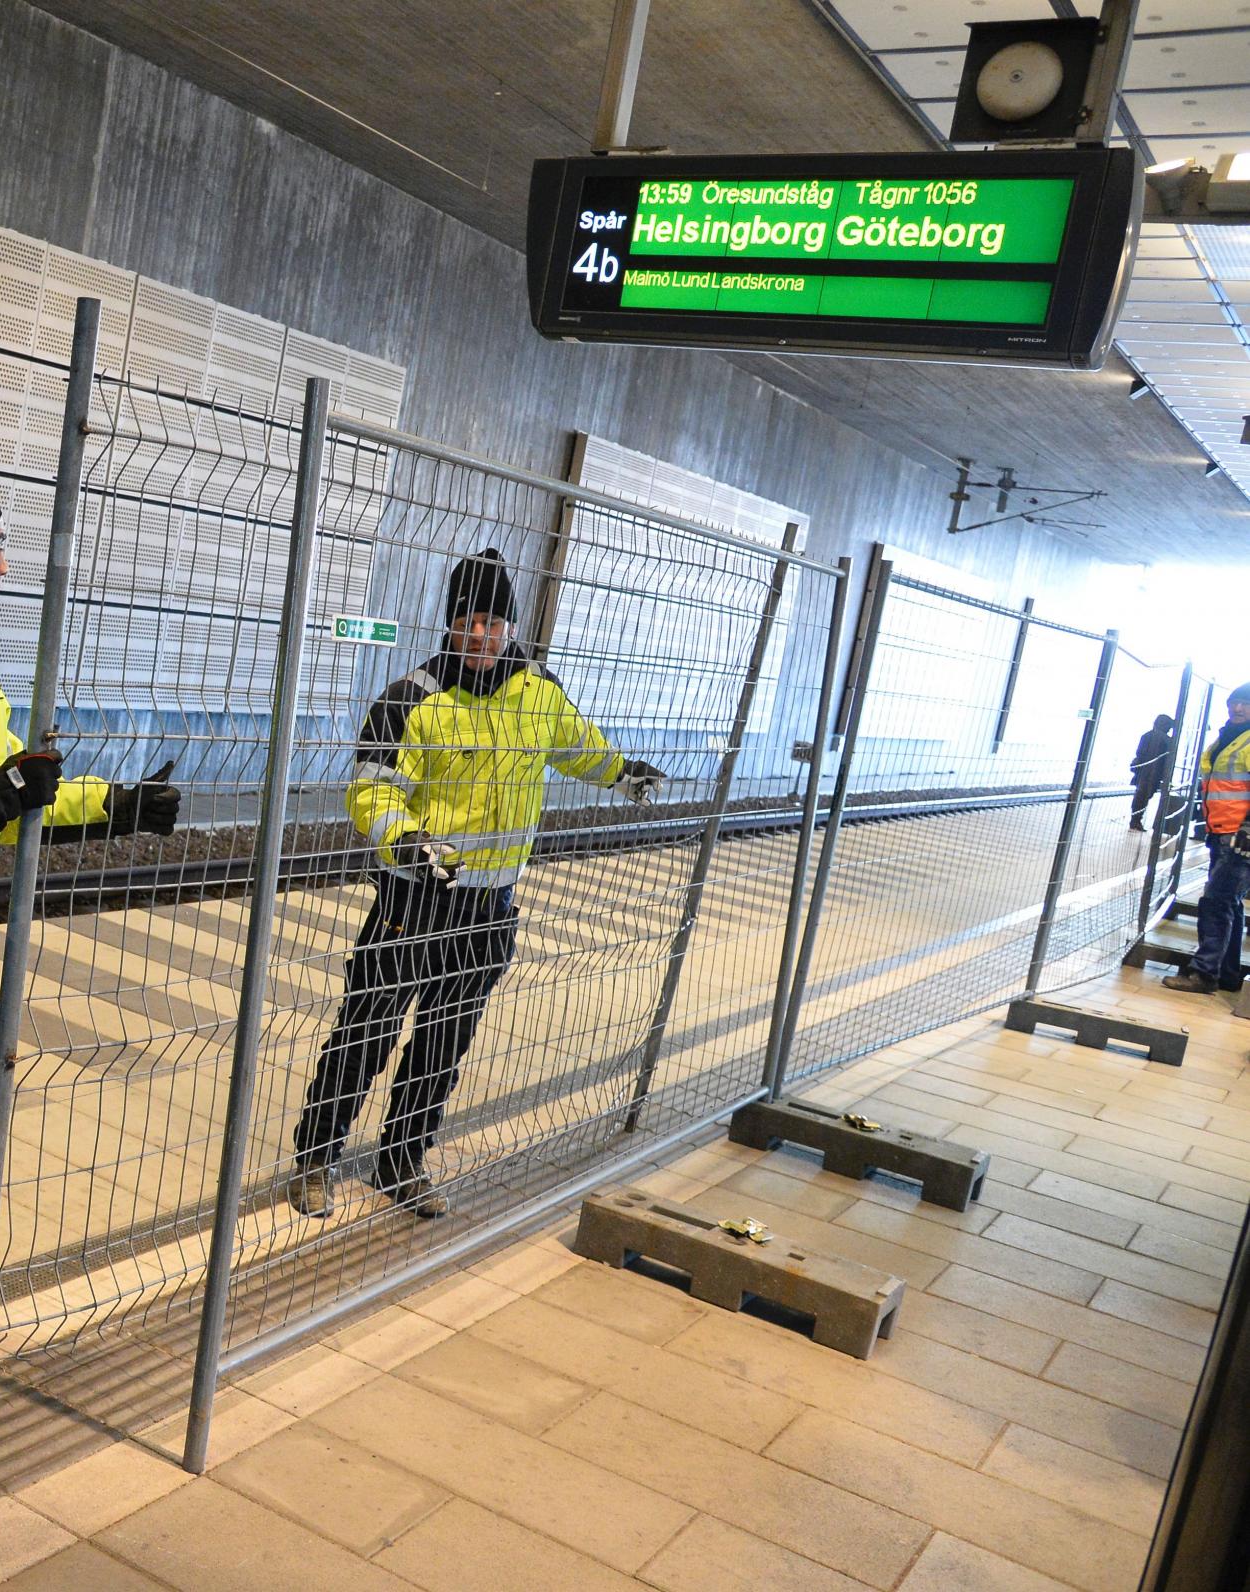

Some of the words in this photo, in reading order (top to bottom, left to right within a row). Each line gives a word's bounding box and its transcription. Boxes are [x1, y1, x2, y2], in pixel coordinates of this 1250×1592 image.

[639, 182, 693, 205] 13:59
[702, 181, 835, 209] Öresundståg
[855, 180, 921, 209] Tågnr
[923, 182, 978, 205] 1056
[579, 210, 628, 233] Spår
[632, 213, 827, 252] Helsingborg
[836, 215, 1006, 255] Göteborg
[572, 242, 620, 283] 4b
[623, 270, 670, 287] Malmö
[672, 271, 710, 288] Lund
[711, 273, 805, 291] Landskrona
